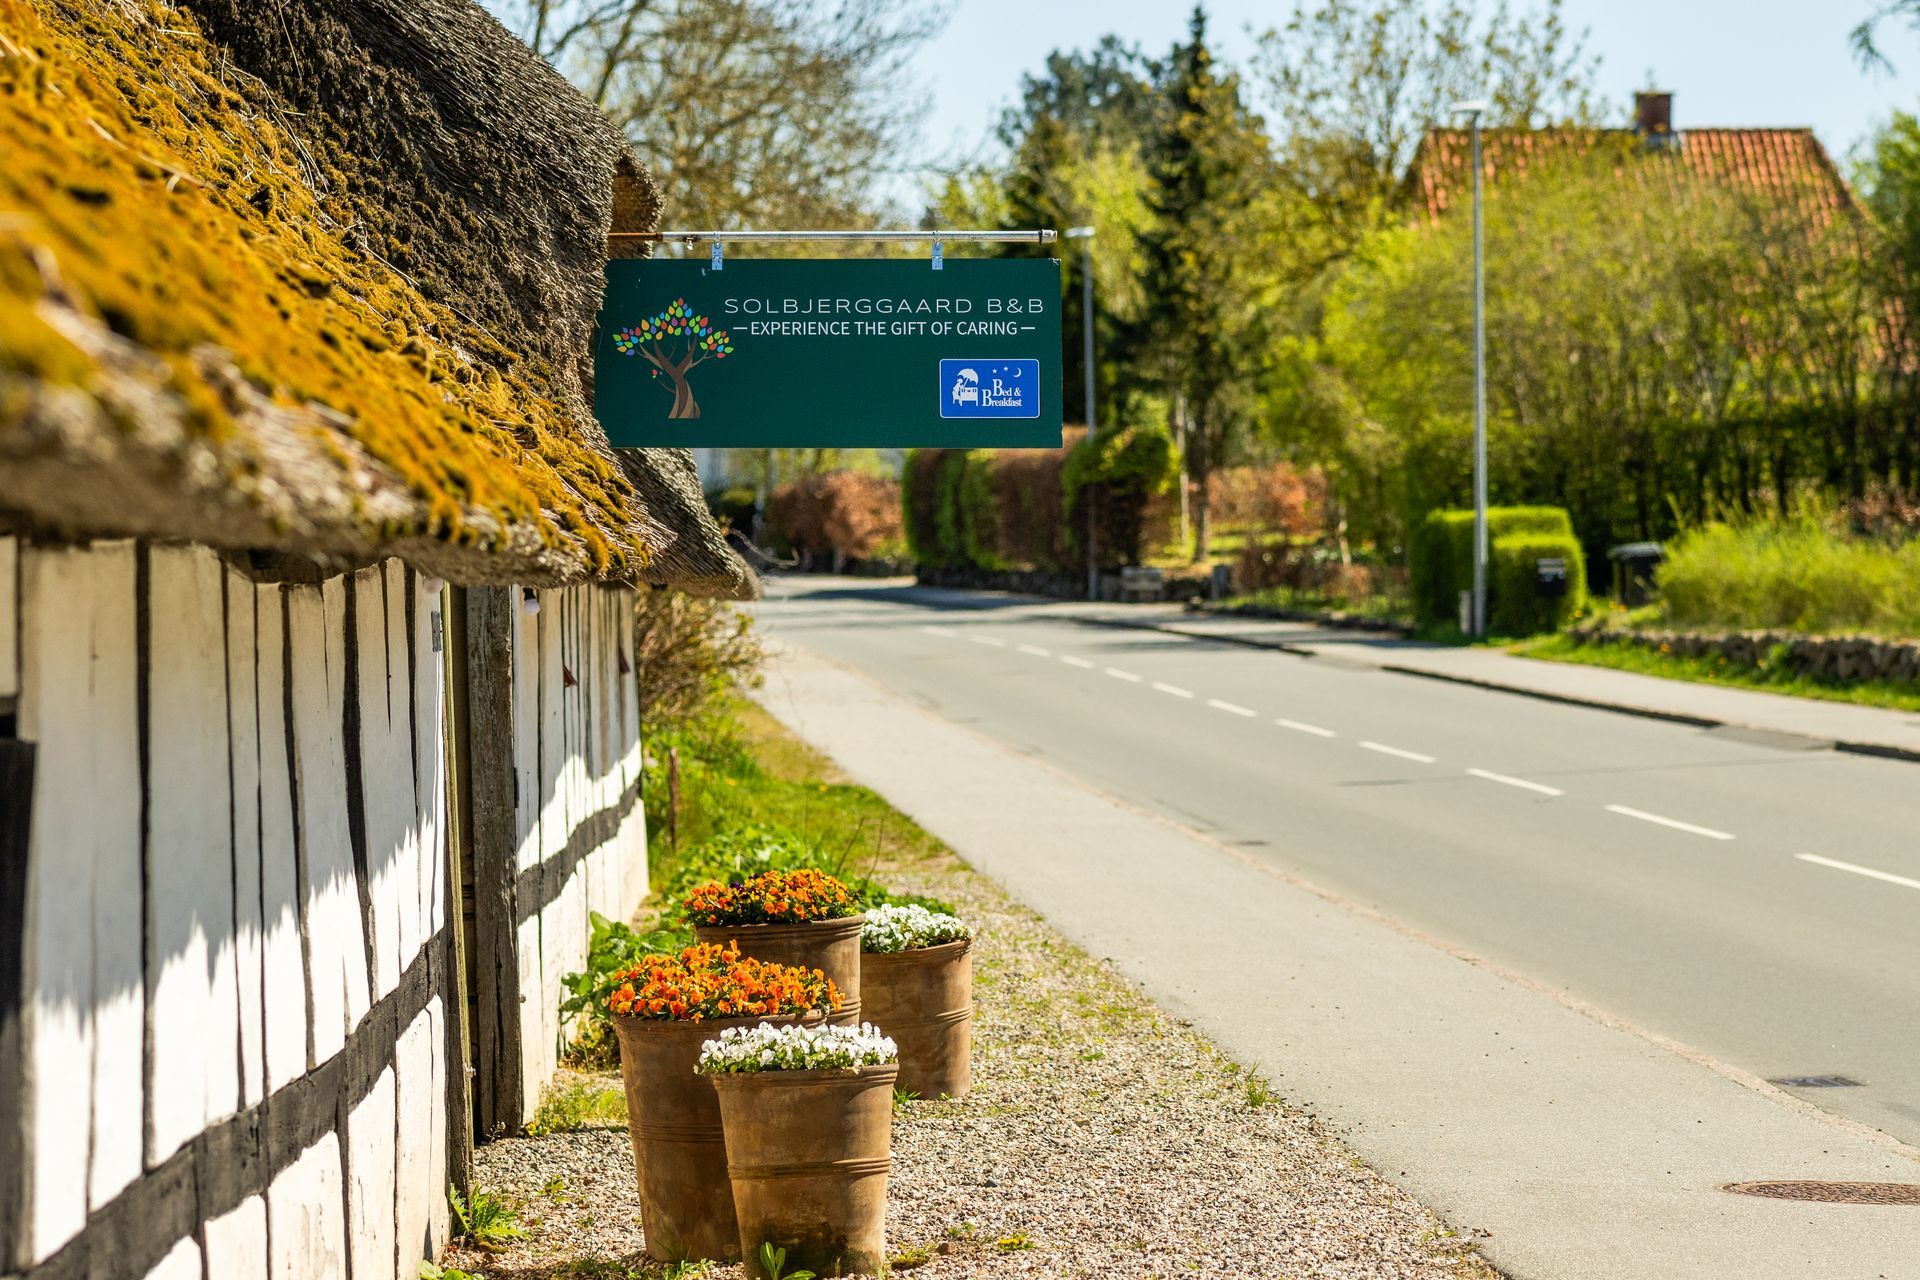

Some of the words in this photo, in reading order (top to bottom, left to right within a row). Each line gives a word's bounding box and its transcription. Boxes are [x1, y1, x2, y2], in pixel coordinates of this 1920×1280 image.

[724, 298, 973, 314] SOLBJERGGAARD
[987, 298, 1044, 314] B&B
[751, 321, 850, 336] EXPERIENCE
[854, 321, 886, 336] THE
[890, 321, 927, 336] GIFT
[930, 321, 952, 336] OF
[956, 321, 1018, 336] CARING
[992, 379, 1012, 396] Bed
[1014, 387, 1021, 396] &
[982, 390, 1022, 406] Breakfast
